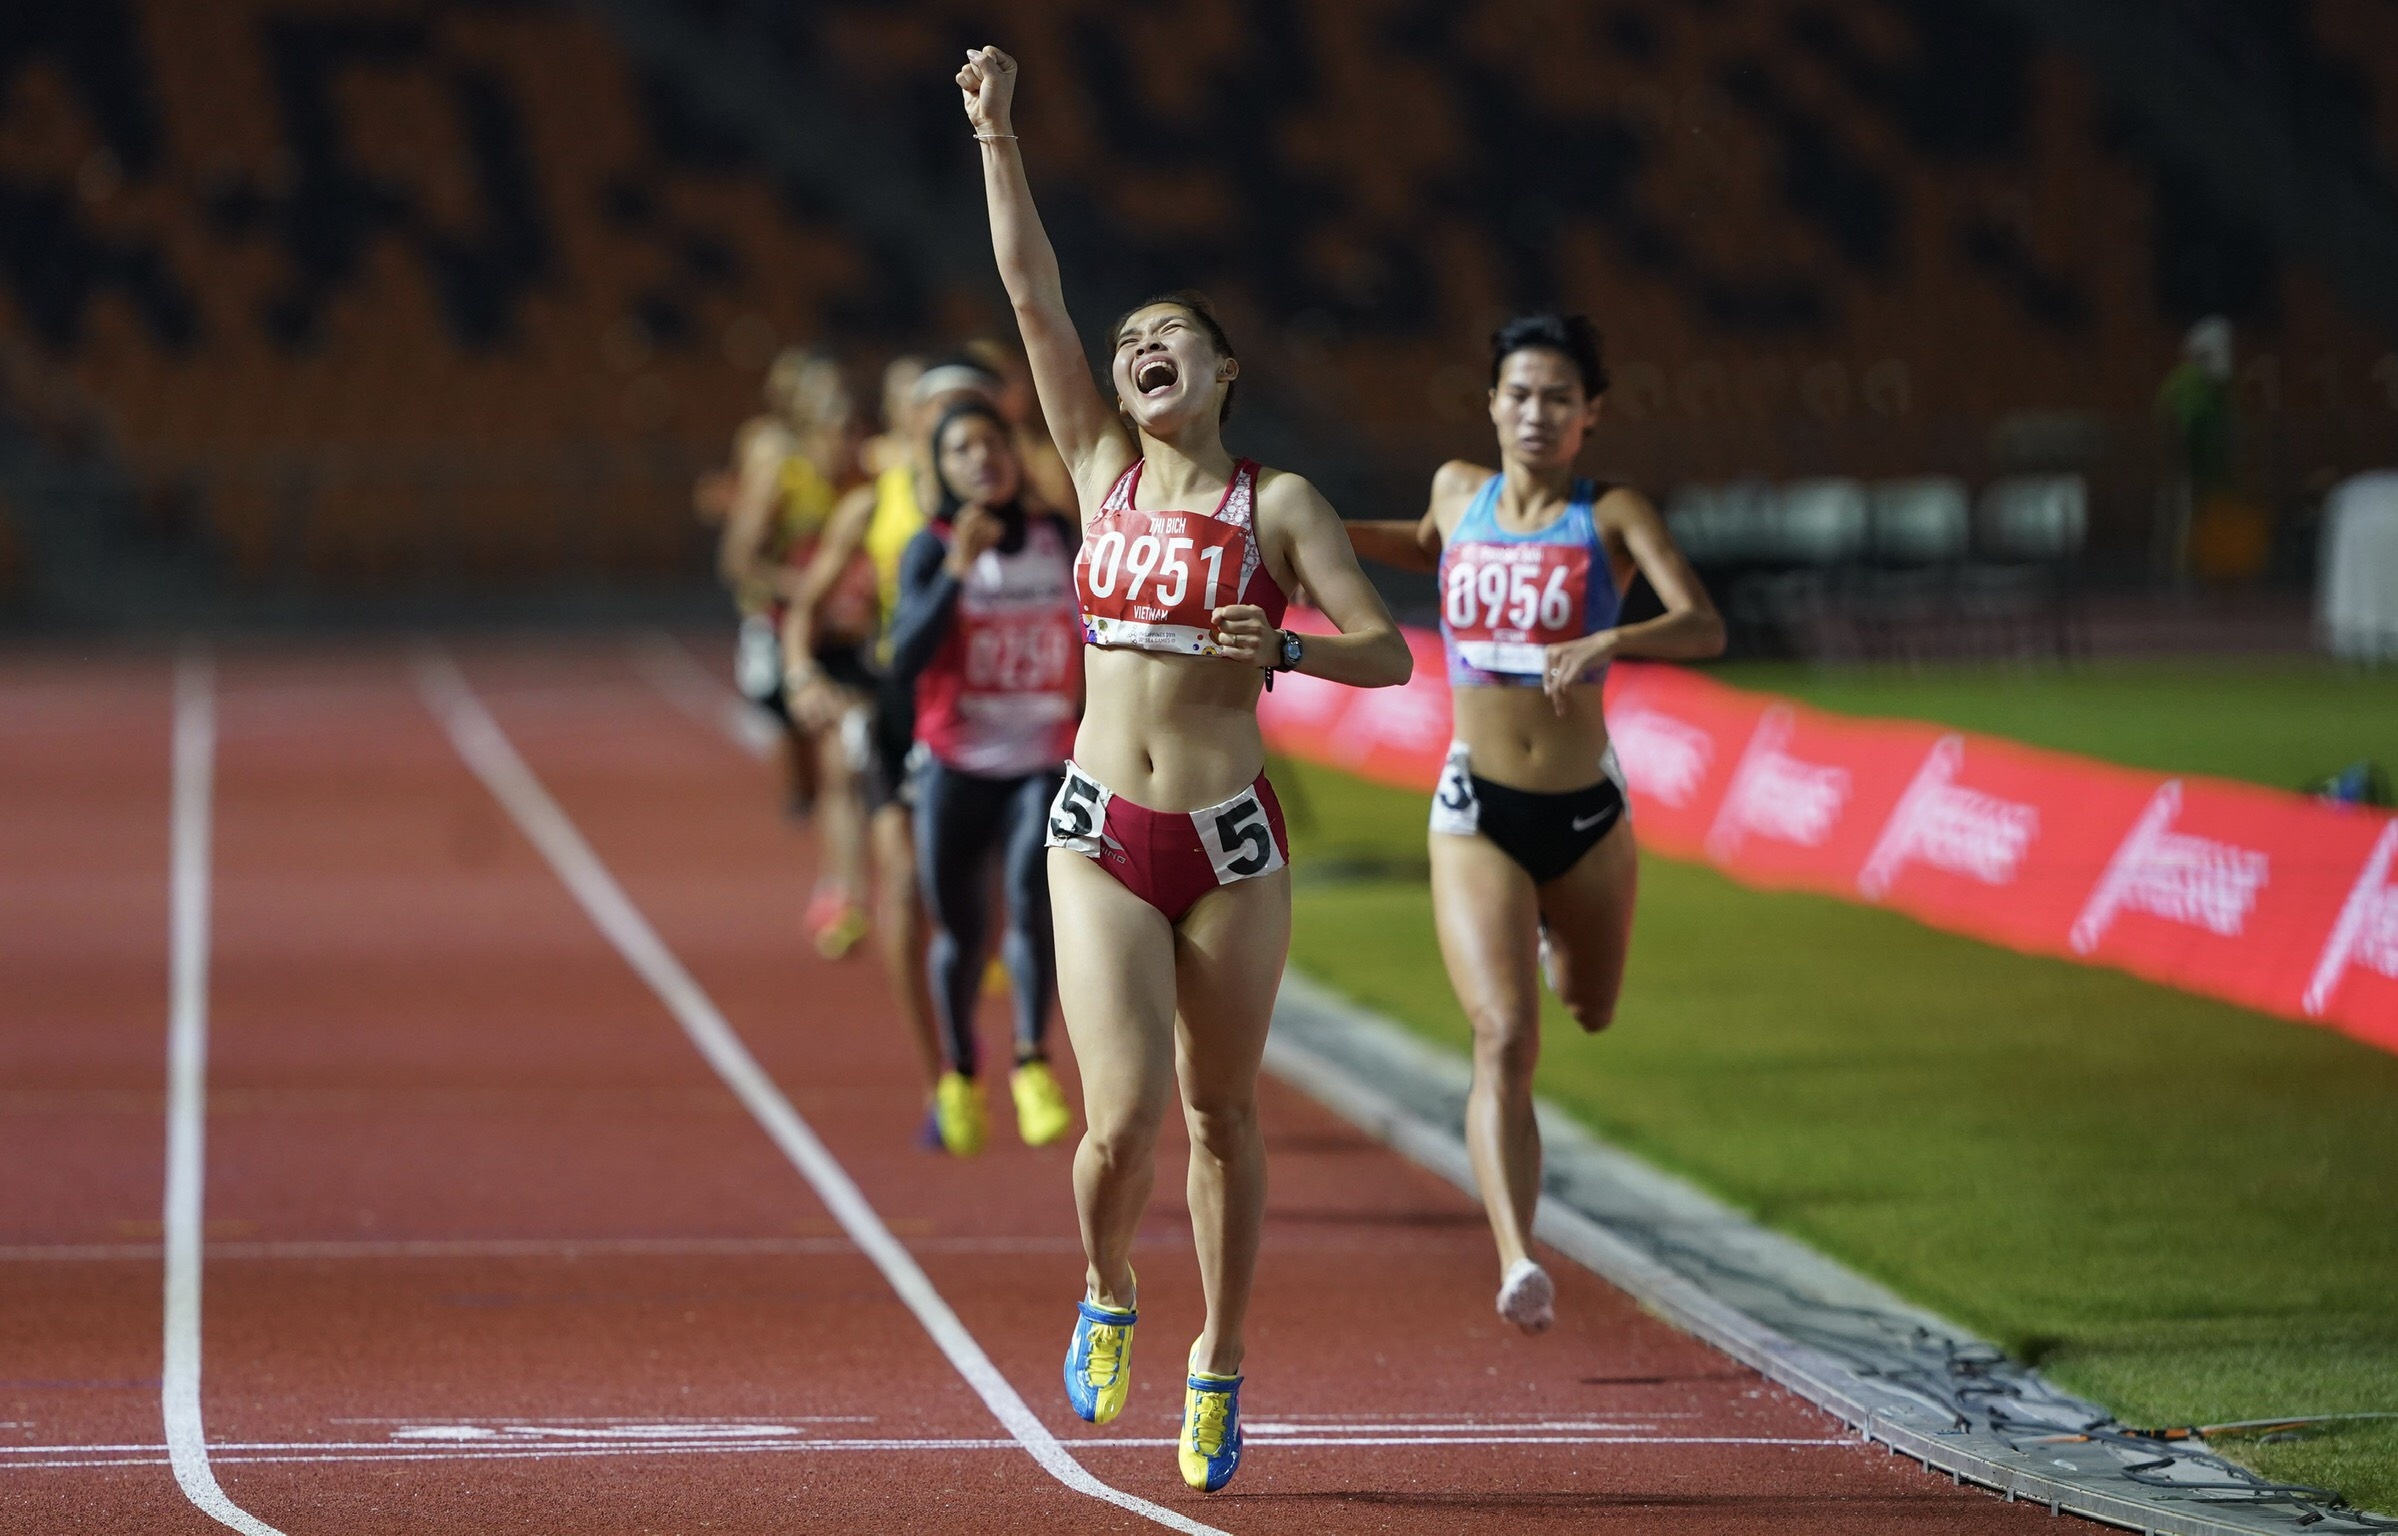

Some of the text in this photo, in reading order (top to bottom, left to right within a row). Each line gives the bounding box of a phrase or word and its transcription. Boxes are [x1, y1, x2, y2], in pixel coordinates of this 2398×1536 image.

[1149, 517, 1187, 534] THI BICH
[1088, 531, 1224, 611] 0951
[1446, 562, 1572, 631] 0956
[1133, 605, 1169, 621] VIETNAM
[1050, 774, 1101, 838] 5
[1214, 797, 1271, 876] 5
